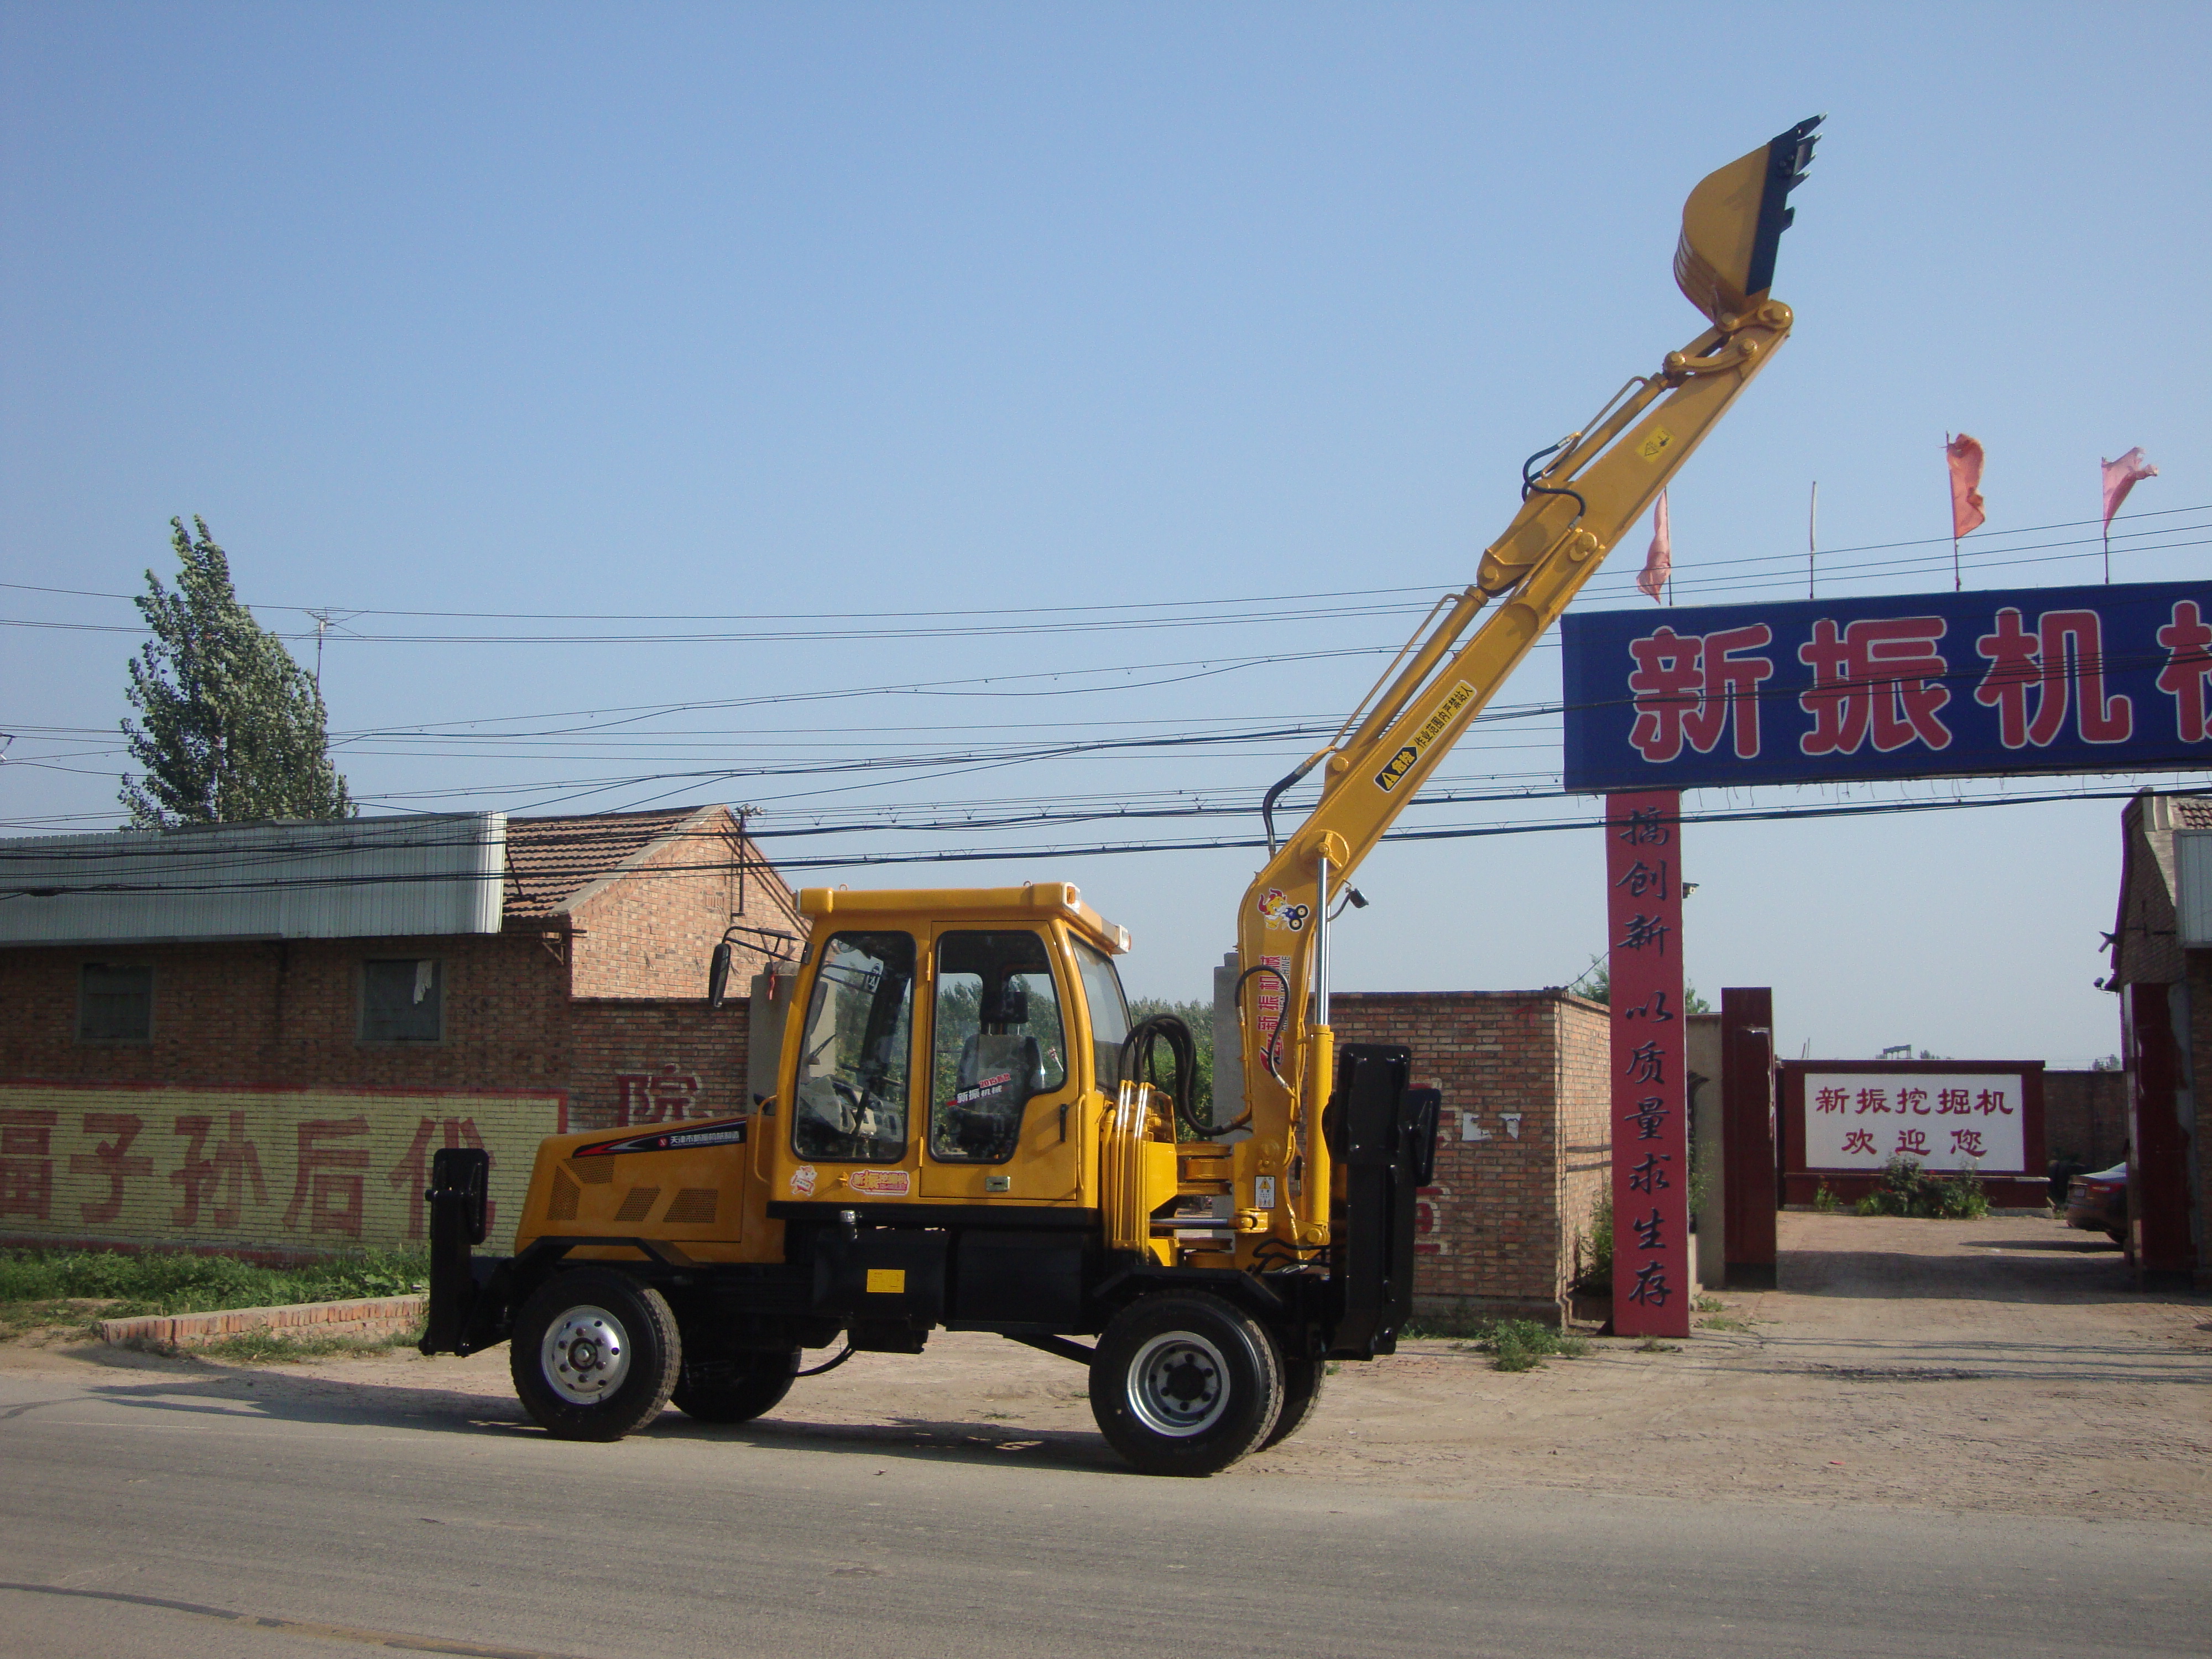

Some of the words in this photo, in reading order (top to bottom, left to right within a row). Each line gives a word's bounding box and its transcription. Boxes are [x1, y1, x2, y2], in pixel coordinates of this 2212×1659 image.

[1414, 686, 1473, 749] 作业范围内严禁站人
[957, 1085, 1002, 1104] 新振机械
[1815, 1086, 2013, 1116] 新振挖掘机
[1841, 1128, 1987, 1157] 欢迎您
